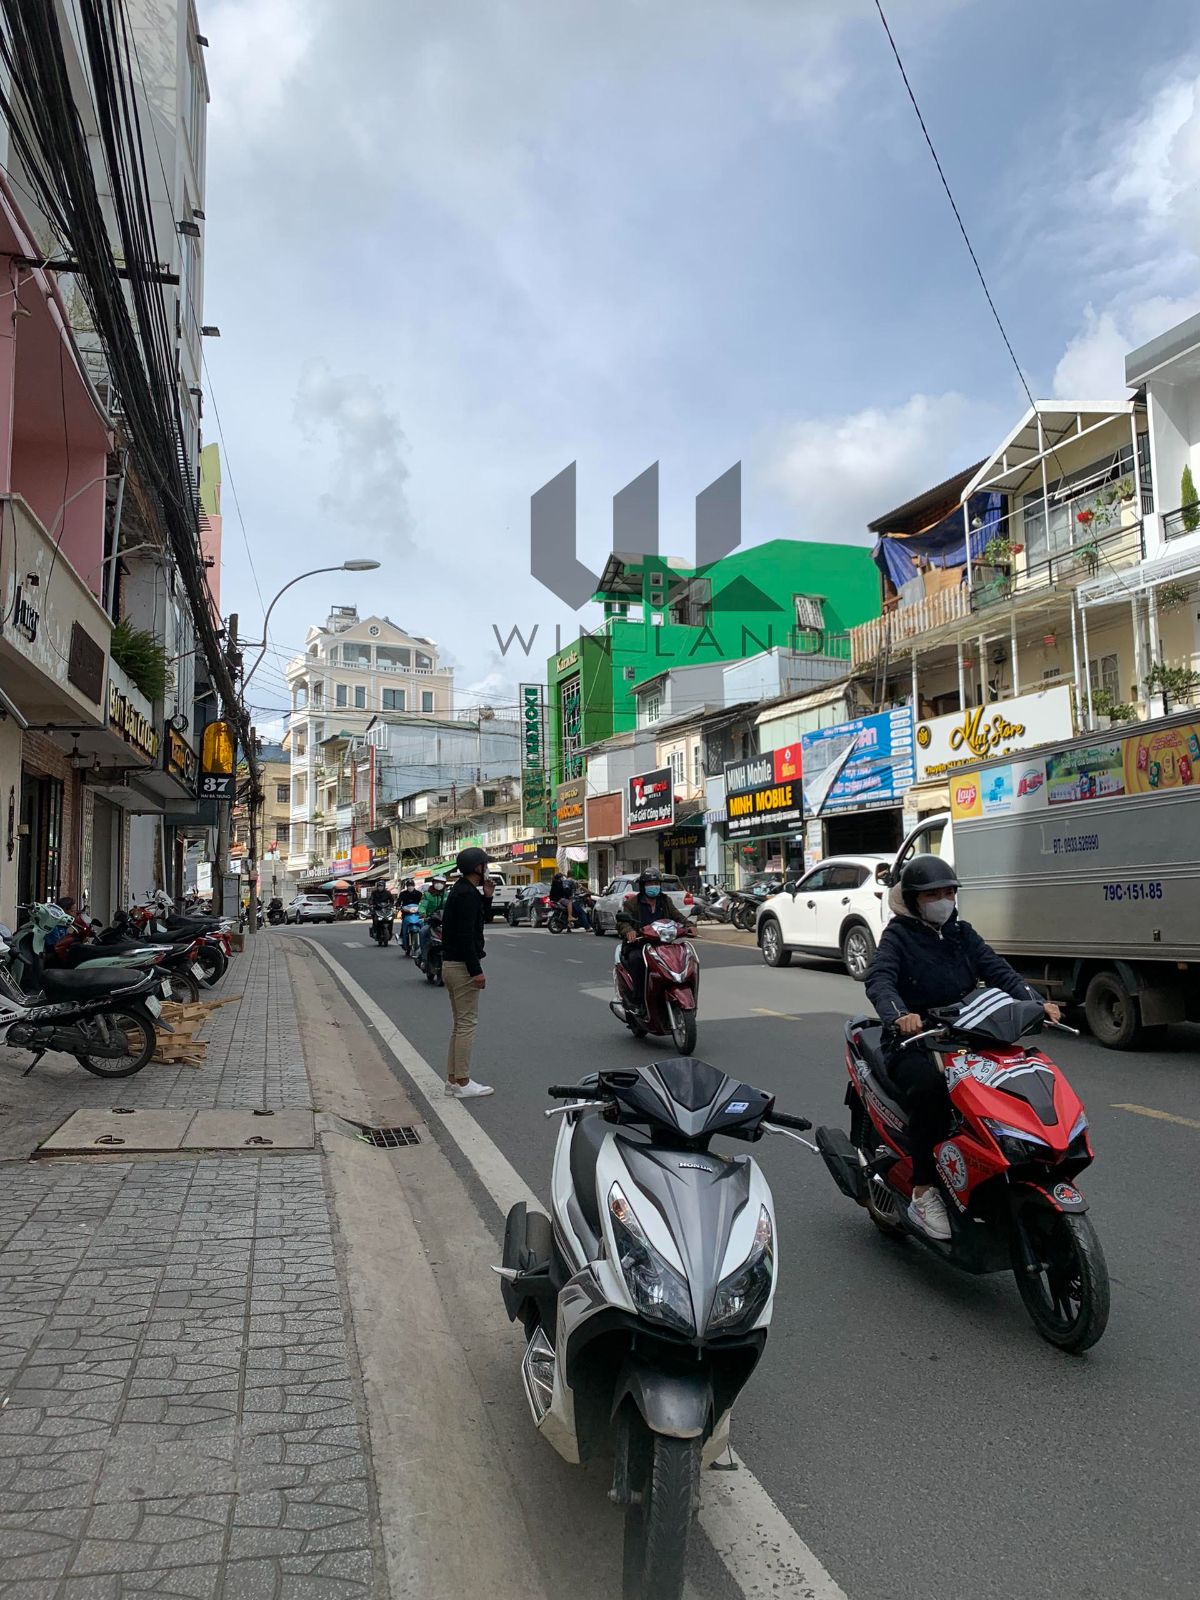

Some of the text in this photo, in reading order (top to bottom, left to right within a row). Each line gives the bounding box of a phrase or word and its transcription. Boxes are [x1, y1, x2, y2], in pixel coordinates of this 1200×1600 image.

[203, 777, 230, 792] 37
[727, 766, 747, 792] MINH
[747, 760, 772, 786] Mobile
[729, 795, 753, 817] MINH
[755, 785, 793, 812] MOBILE
[956, 785, 977, 805] Lay's
[679, 1162, 713, 1173] HONDA
